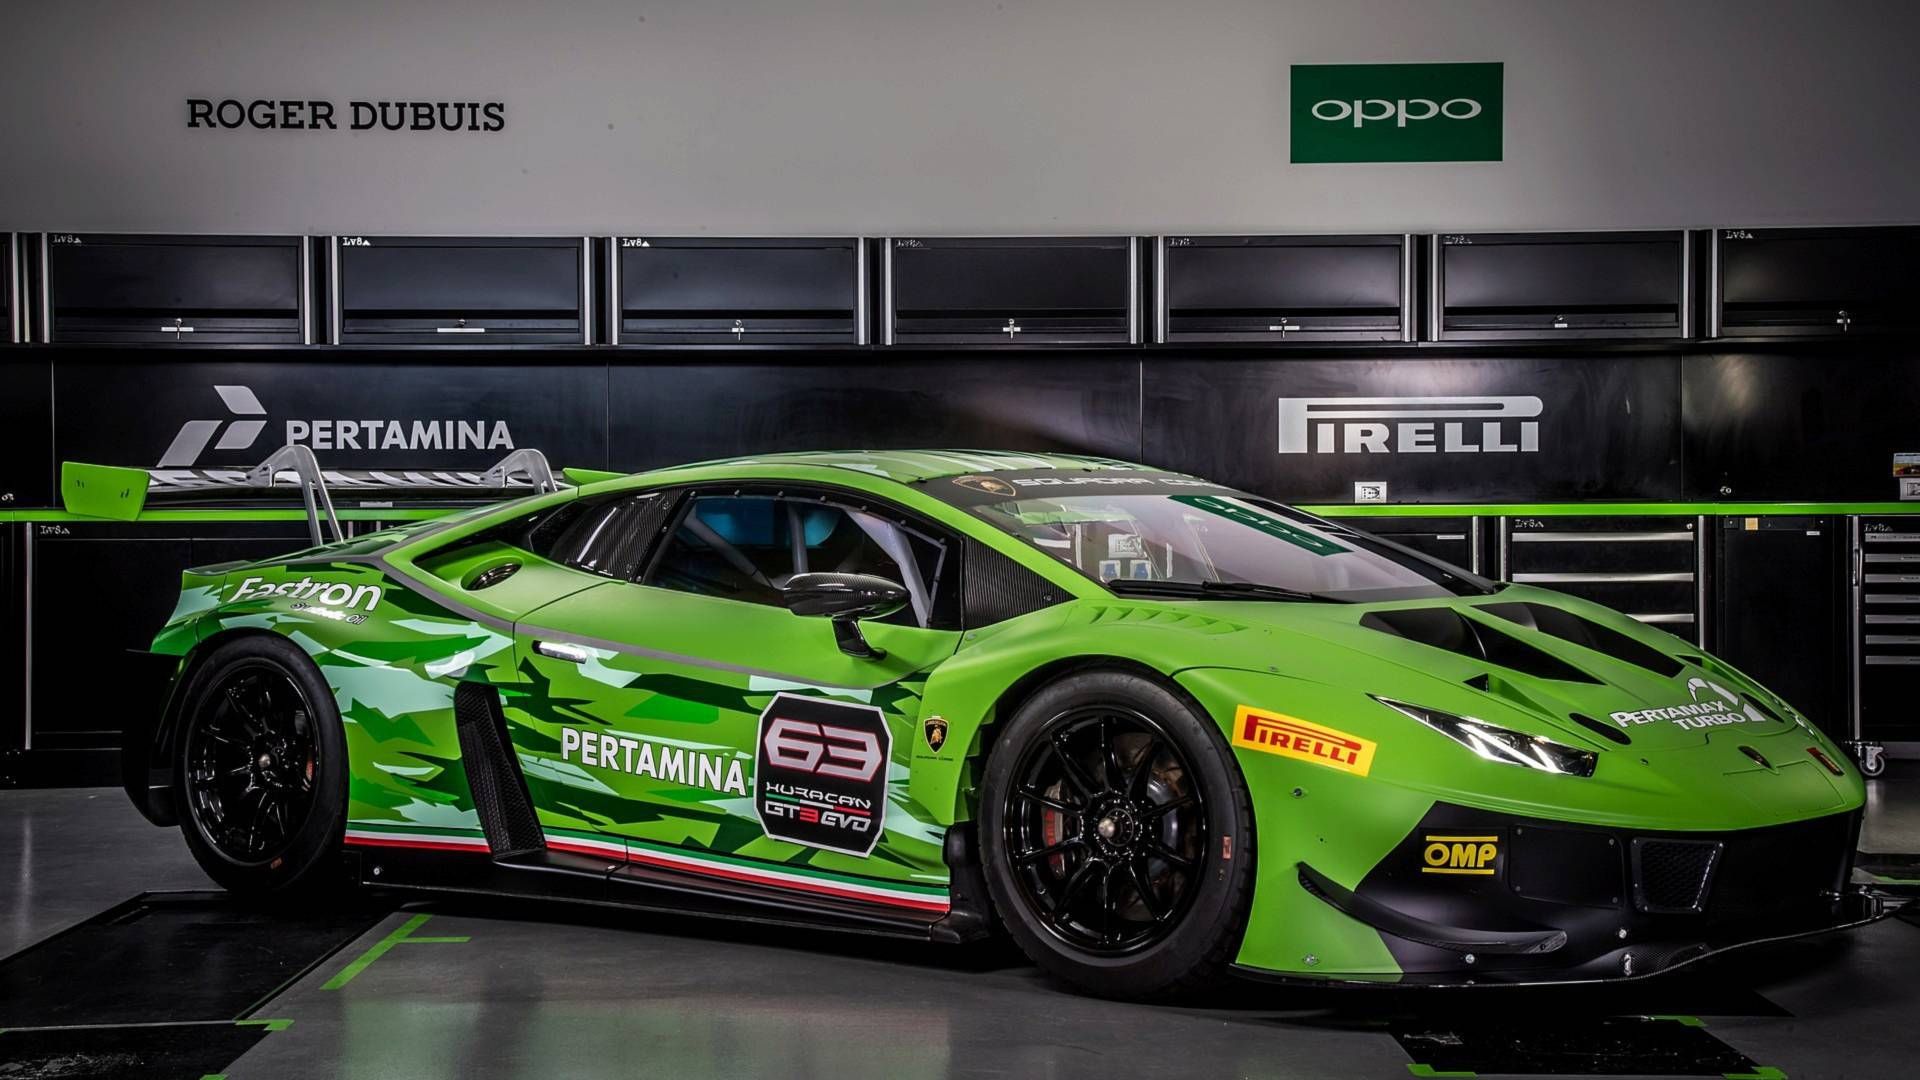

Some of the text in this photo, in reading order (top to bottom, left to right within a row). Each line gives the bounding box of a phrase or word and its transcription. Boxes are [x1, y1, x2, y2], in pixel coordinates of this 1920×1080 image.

[187, 99, 505, 132] ROGER DUBUIS
[1311, 98, 1482, 128] oppo
[286, 420, 515, 450] PERTAMINA
[1278, 396, 1544, 453] PIRELLI
[227, 577, 382, 612] Fastron
[1610, 701, 1731, 728] PERTAMAX
[1672, 712, 1746, 730] TURBO
[764, 717, 883, 783] 63
[1243, 714, 1362, 765] PIRELLI
[561, 726, 747, 797] PERTAMINA
[1424, 843, 1497, 868] OMP
